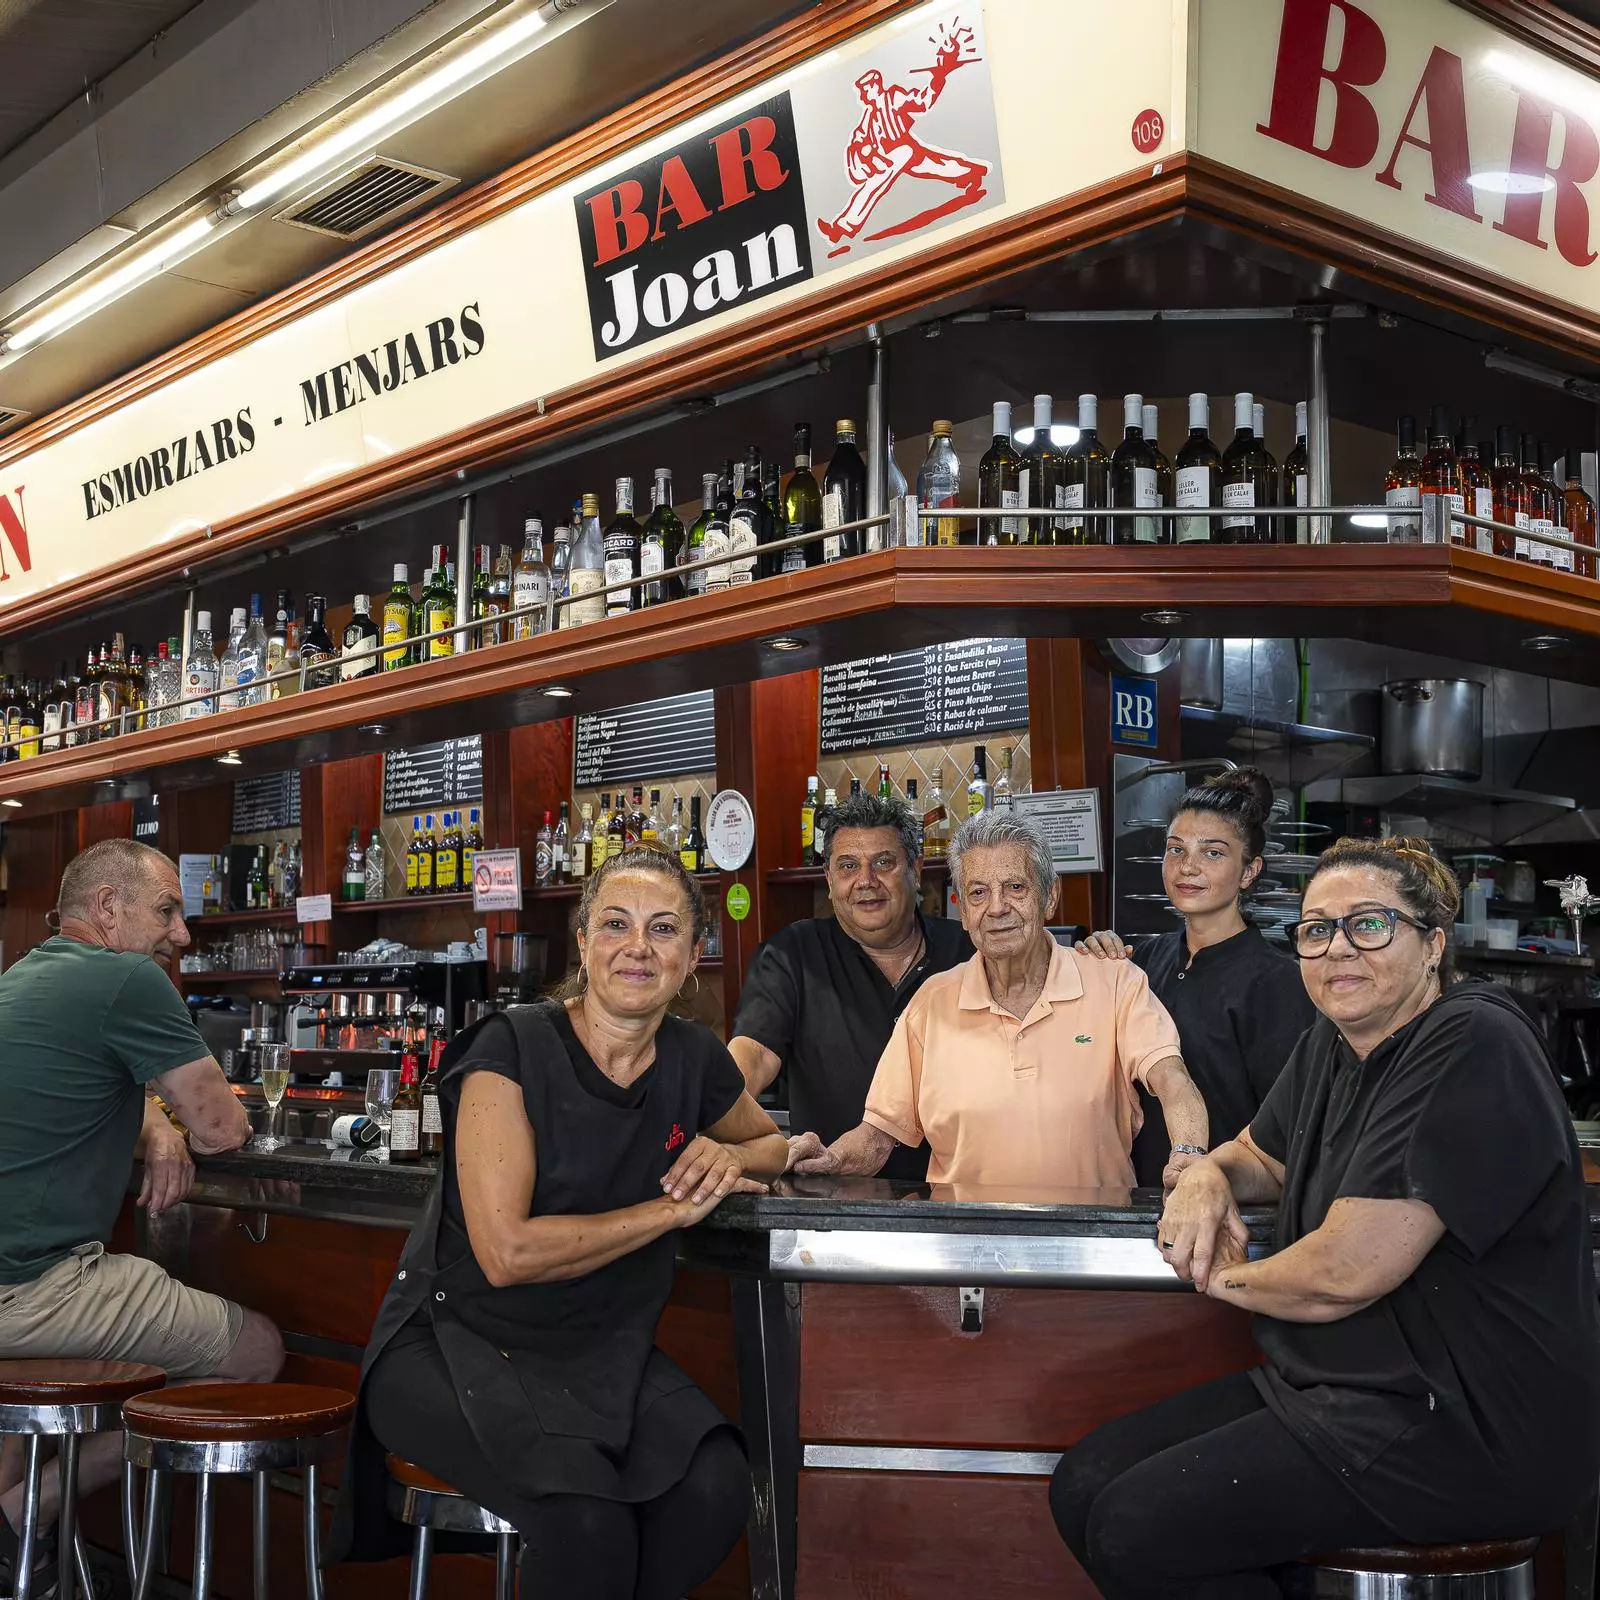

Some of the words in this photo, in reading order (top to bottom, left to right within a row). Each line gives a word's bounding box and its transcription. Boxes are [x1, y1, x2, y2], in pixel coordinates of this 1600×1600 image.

[1133, 117, 1162, 145] 108
[1256, 0, 1600, 267] BAR
[583, 115, 789, 268] BAR
[601, 222, 803, 347] Joan
[81, 406, 256, 521] ESMORZARS
[299, 301, 485, 427] MENJARS
[944, 674, 970, 685] Patates
[972, 670, 995, 680] Braves
[944, 686, 970, 697] Patates
[971, 682, 992, 693] Chips
[944, 709, 966, 720] Rabas
[967, 707, 976, 716] de
[977, 704, 1008, 715] calamar
[965, 719, 973, 728] de
[1115, 691, 1154, 729] RB
